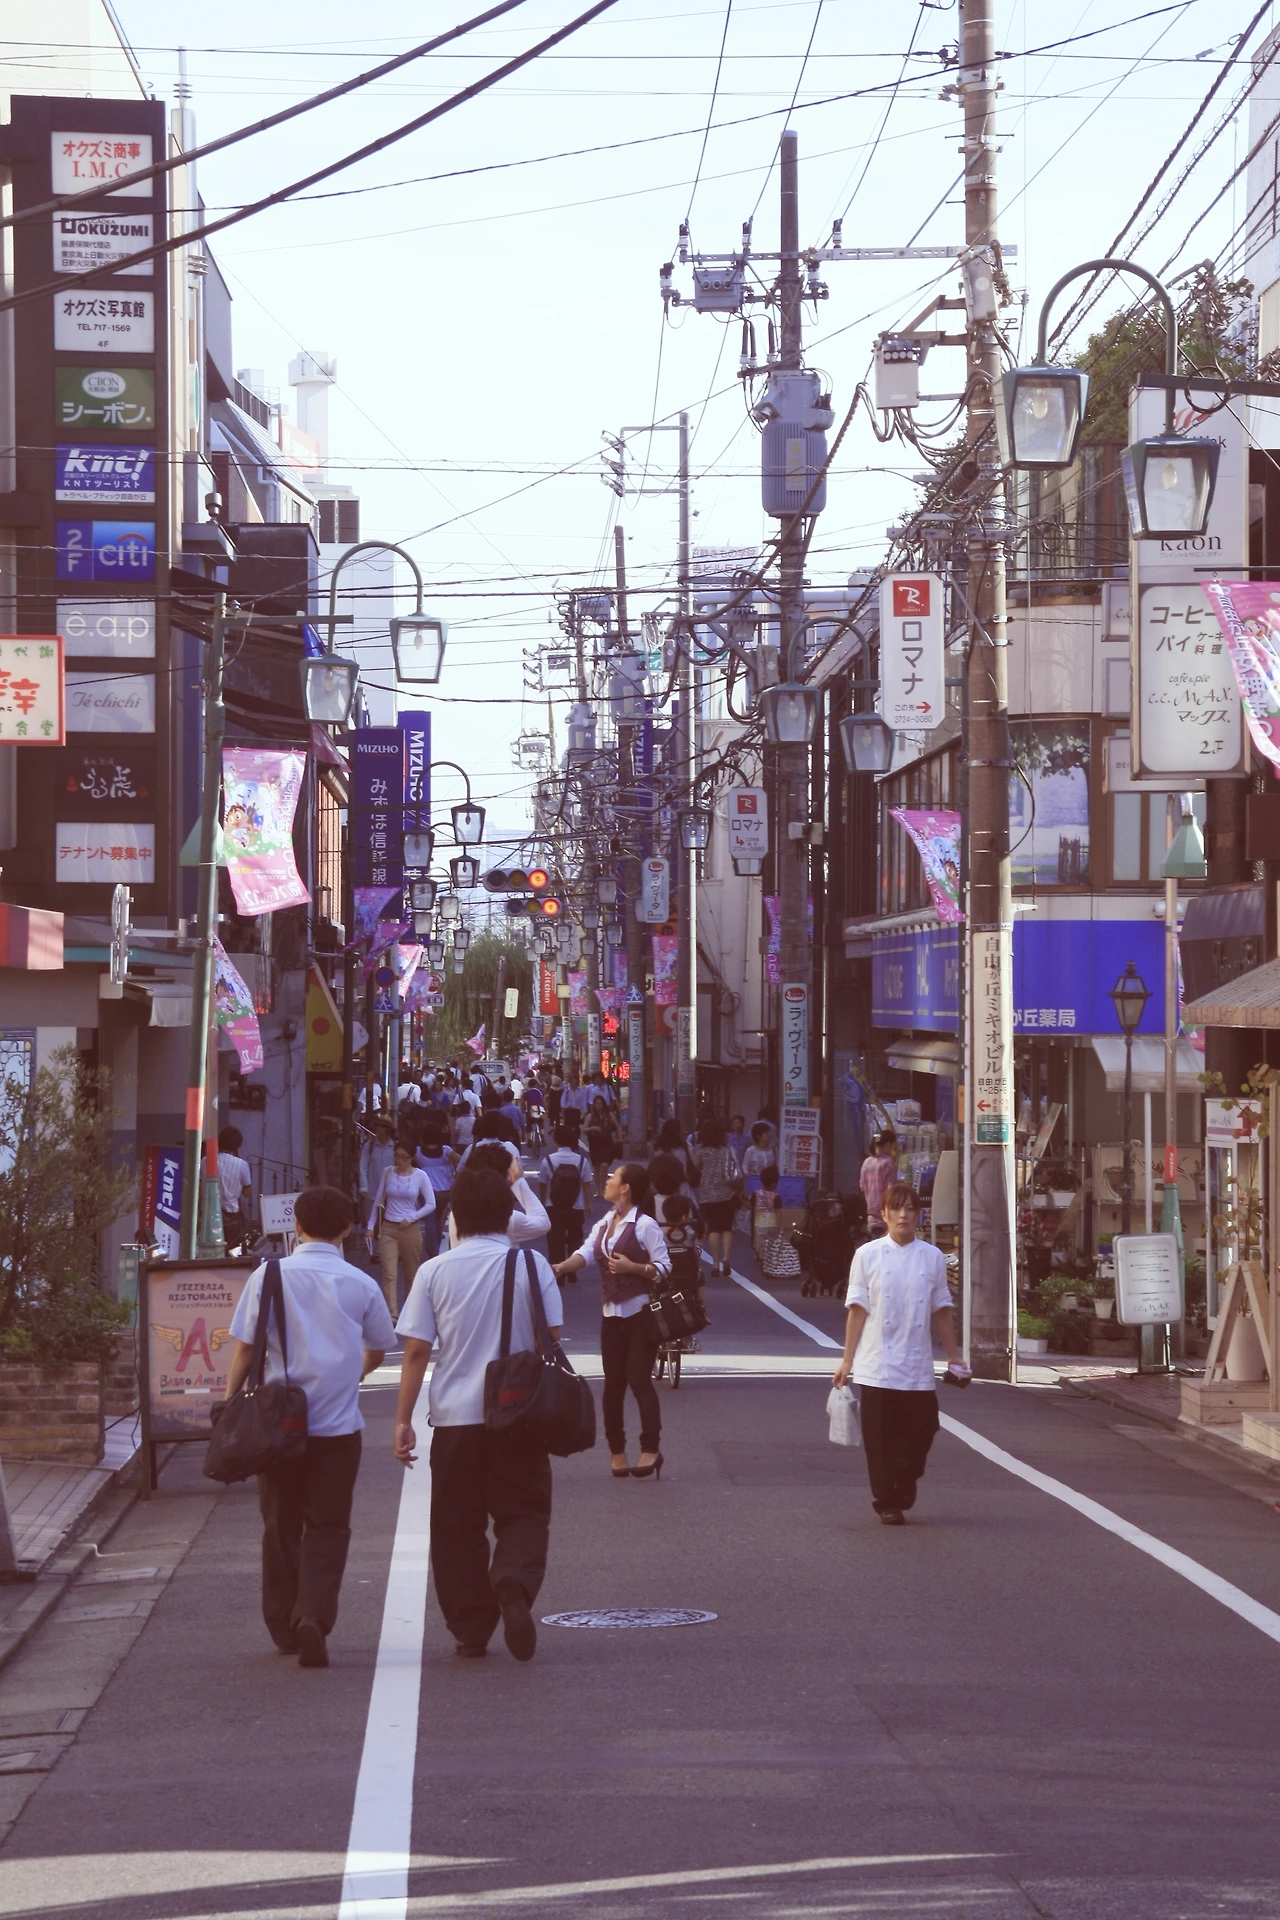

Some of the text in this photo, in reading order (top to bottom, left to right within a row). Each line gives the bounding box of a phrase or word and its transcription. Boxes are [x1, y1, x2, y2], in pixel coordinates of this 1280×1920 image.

[63, 140, 142, 160] オクズミ商事
[78, 223, 149, 237] OKUZUMI
[63, 298, 145, 318] オクズミ写真館
[77, 323, 131, 332] TEL 717-1569
[99, 540, 148, 567] citi
[1156, 634, 1191, 652] パイ
[1196, 631, 1224, 642] ケーキ
[901, 620, 924, 695] ロマナ
[1193, 673, 1211, 686] pie
[94, 692, 141, 708] chichi
[894, 703, 916, 712] この先
[357, 743, 399, 754] MIZUHO
[1199, 740, 1224, 755] 2F
[731, 819, 764, 832] ロマナ
[59, 846, 152, 861] テナント募集中
[984, 936, 1003, 1075] 自由が丘ミキオビル
[788, 1006, 803, 1080] ラ・ヴィータ
[176, 1283, 225, 1292] PIZZERIA
[168, 1293, 233, 1302] RISTORANTE
